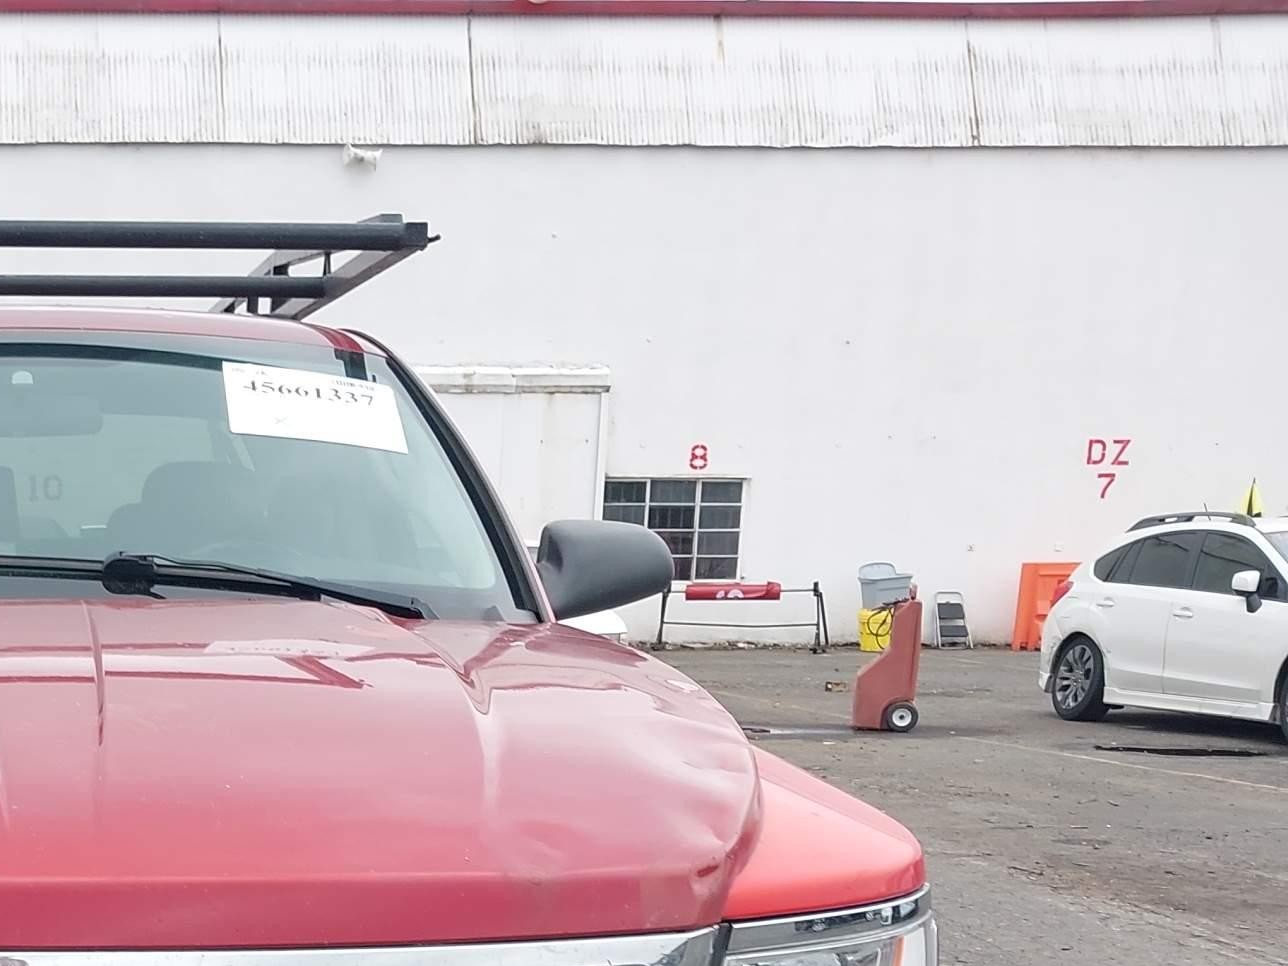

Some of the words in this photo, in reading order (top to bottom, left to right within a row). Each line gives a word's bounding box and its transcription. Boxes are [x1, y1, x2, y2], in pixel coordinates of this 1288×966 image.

[243, 379, 375, 406] 45661337
[689, 444, 708, 470] 8
[1086, 439, 1131, 465] DZ
[28, 474, 63, 502] 10
[1097, 473, 1116, 499] 7
